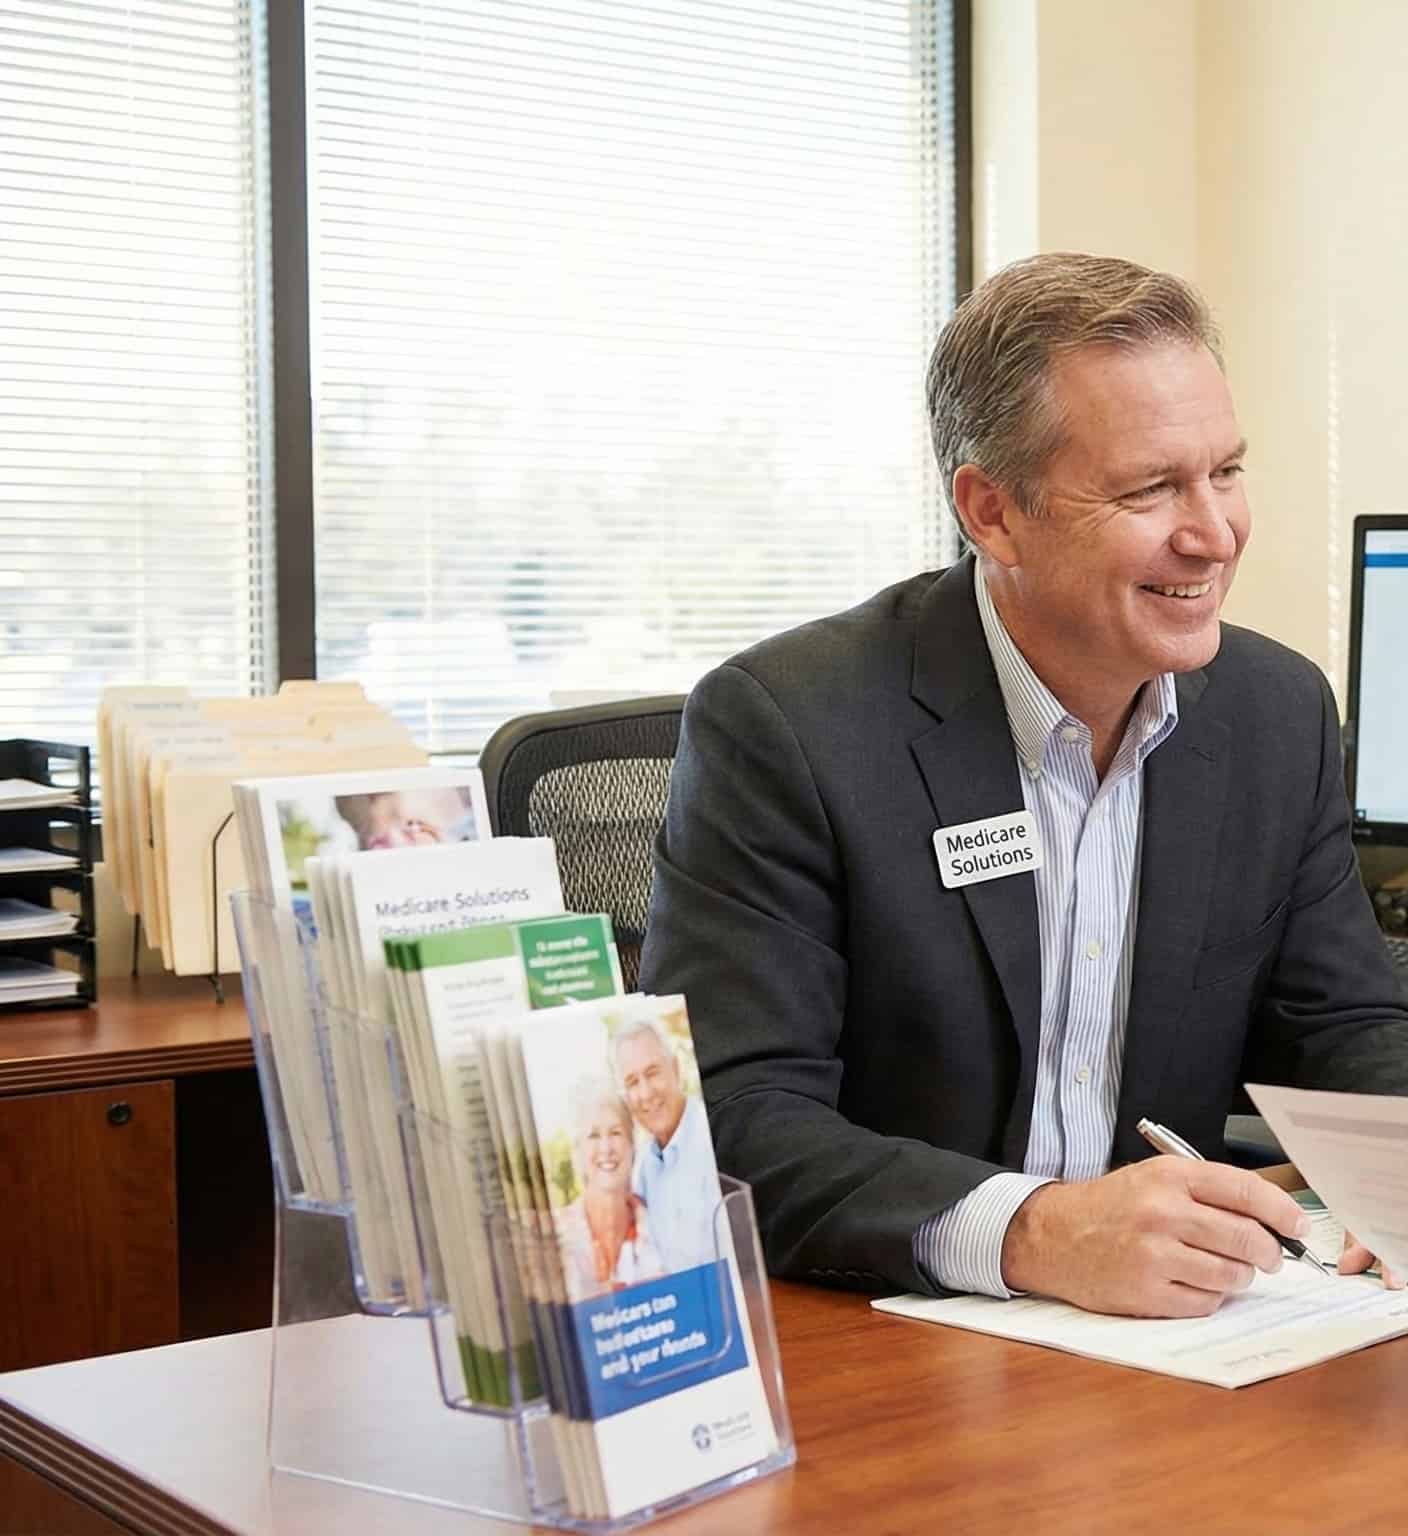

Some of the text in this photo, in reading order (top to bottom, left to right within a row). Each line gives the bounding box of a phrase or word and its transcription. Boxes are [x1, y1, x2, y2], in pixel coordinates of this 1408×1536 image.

[946, 825, 1026, 853] Medicare
[951, 847, 1034, 876] Solutions
[376, 889, 530, 916] Medicare Solutions
